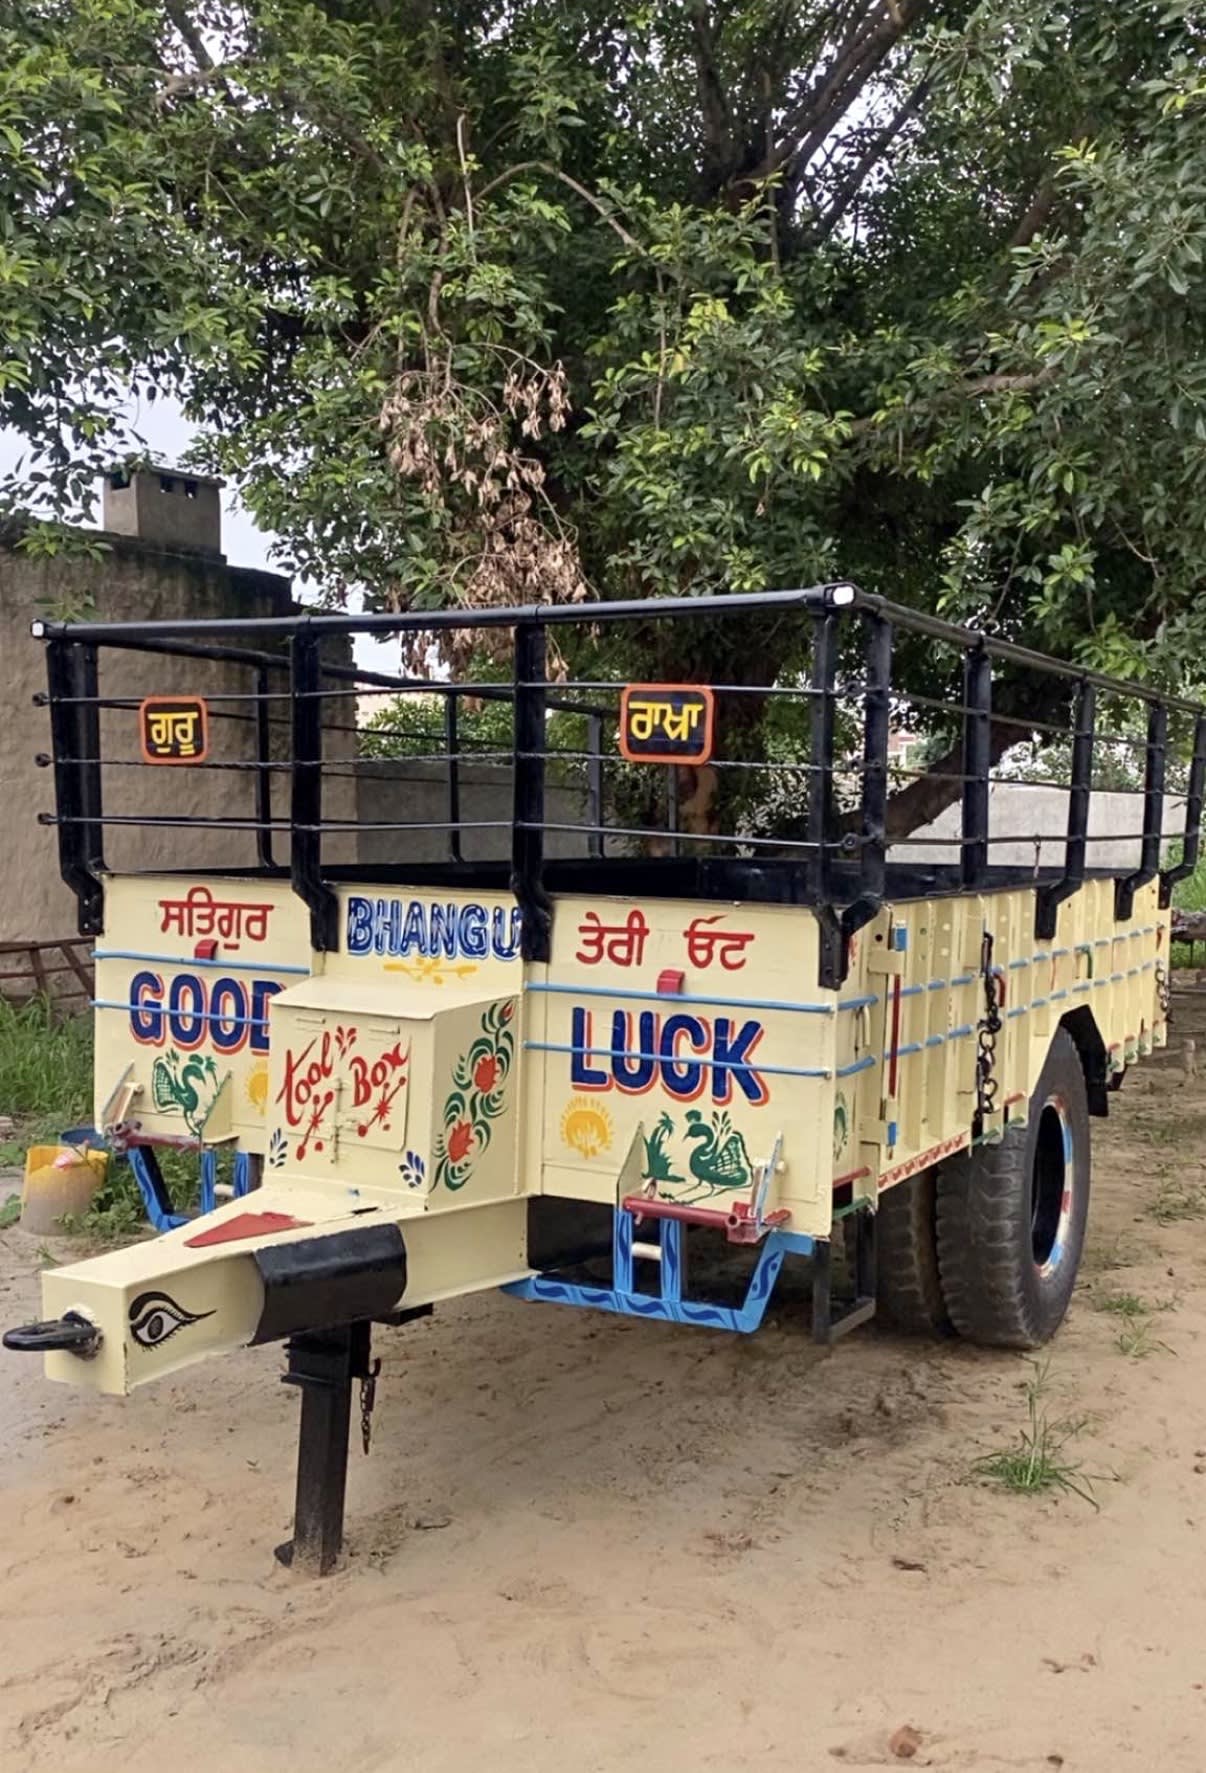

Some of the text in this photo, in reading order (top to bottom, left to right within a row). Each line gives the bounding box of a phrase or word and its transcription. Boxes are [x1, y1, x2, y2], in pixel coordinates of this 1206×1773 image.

[147, 711, 199, 756] ਗੁਰੂ
[628, 701, 704, 741] ਰਾਖਾ
[158, 886, 275, 950] ਸਤਿਗੁਰ
[347, 896, 525, 961] BHANGU
[575, 910, 755, 970] ਤੇਰੀ ਓਟ
[275, 1030, 409, 1127] Tool Box
[570, 1006, 769, 1107] LUCK
